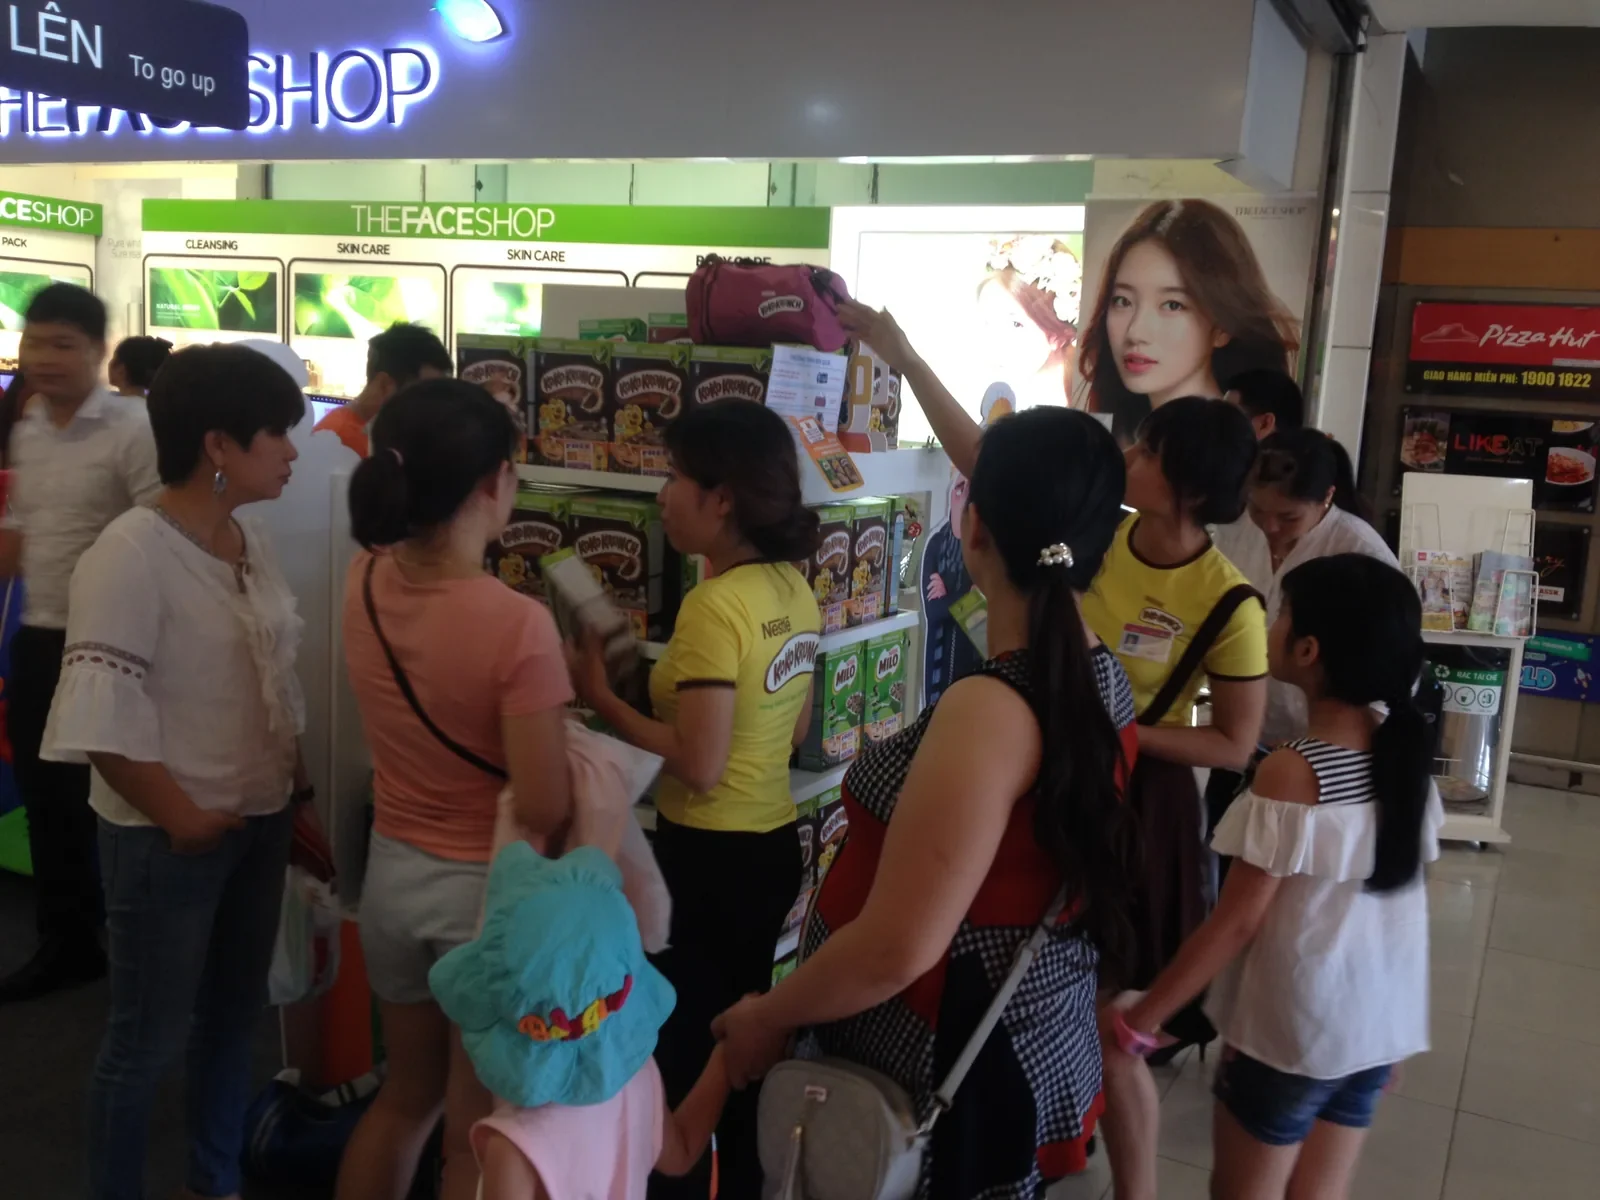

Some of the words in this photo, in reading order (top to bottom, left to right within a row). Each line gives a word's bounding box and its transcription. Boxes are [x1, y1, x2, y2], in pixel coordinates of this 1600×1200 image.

[9, 1, 103, 69] LÊN
[129, 54, 155, 79] To
[161, 67, 186, 90] go
[192, 74, 216, 96] up
[2, 236, 28, 248] PACK
[185, 239, 238, 251] CLEANSING
[337, 242, 360, 254] SKIN
[361, 243, 390, 255] CARE
[507, 248, 532, 260] SKIN
[533, 249, 566, 262] CARE
[1479, 323, 1547, 348] Pizza
[1549, 326, 1600, 348] Hut
[1423, 370, 1445, 381] GIAO
[1521, 370, 1555, 386] 1900
[1558, 372, 1592, 388] 1822
[761, 616, 792, 640] Nestlé
[773, 648, 794, 687] KOKO
[879, 654, 899, 675] MILO
[836, 664, 856, 687] MILO
